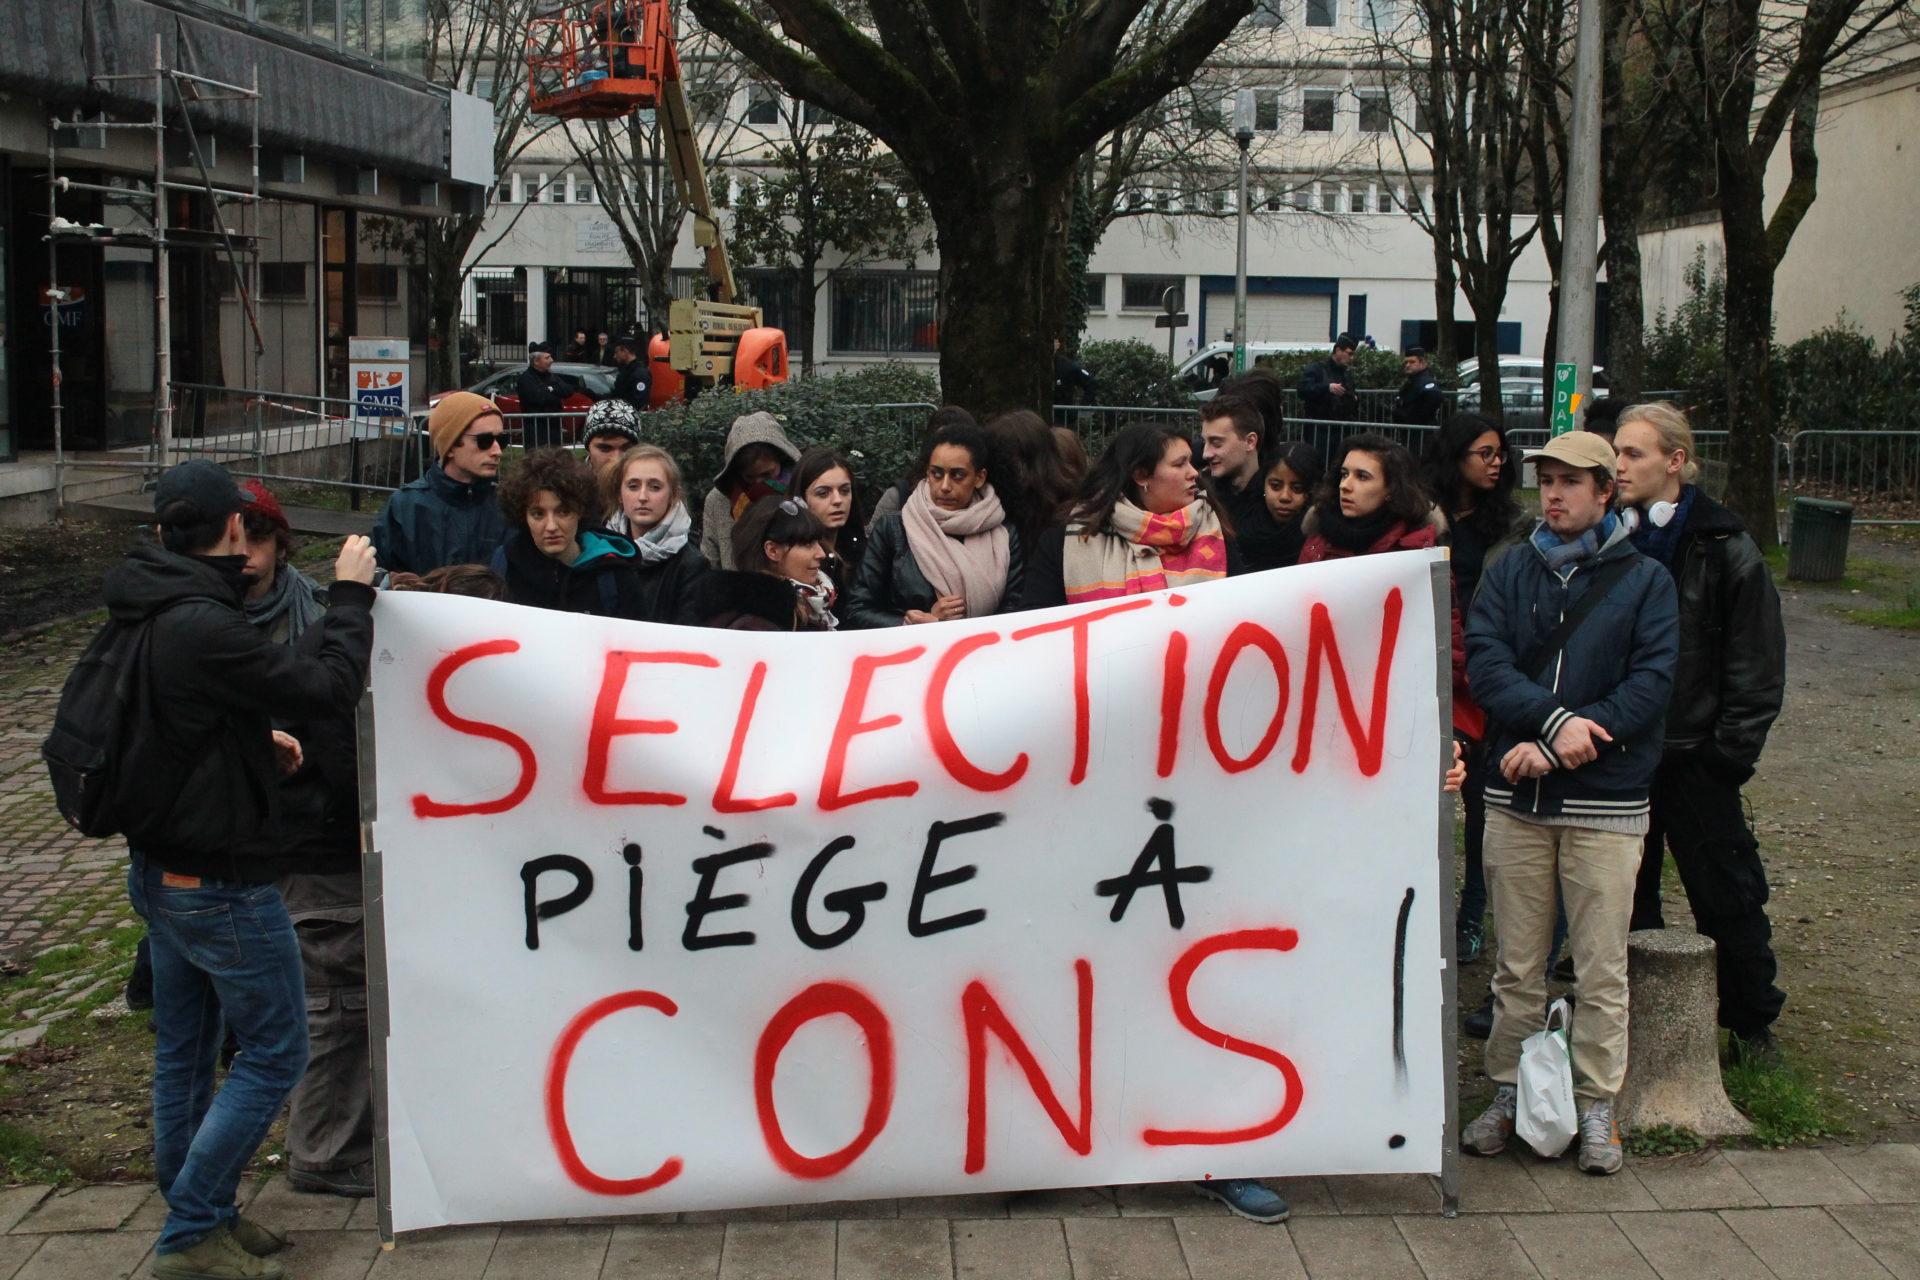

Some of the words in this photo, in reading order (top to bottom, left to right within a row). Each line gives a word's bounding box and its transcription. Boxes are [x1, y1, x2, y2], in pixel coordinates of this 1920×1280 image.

[361, 395, 400, 411] GMF
[411, 586, 1404, 820] SELECTION
[520, 812, 1005, 952] PIÈGE
[1094, 796, 1213, 930] À
[545, 926, 1306, 1197] CONS
[1388, 887, 1416, 1149] !
